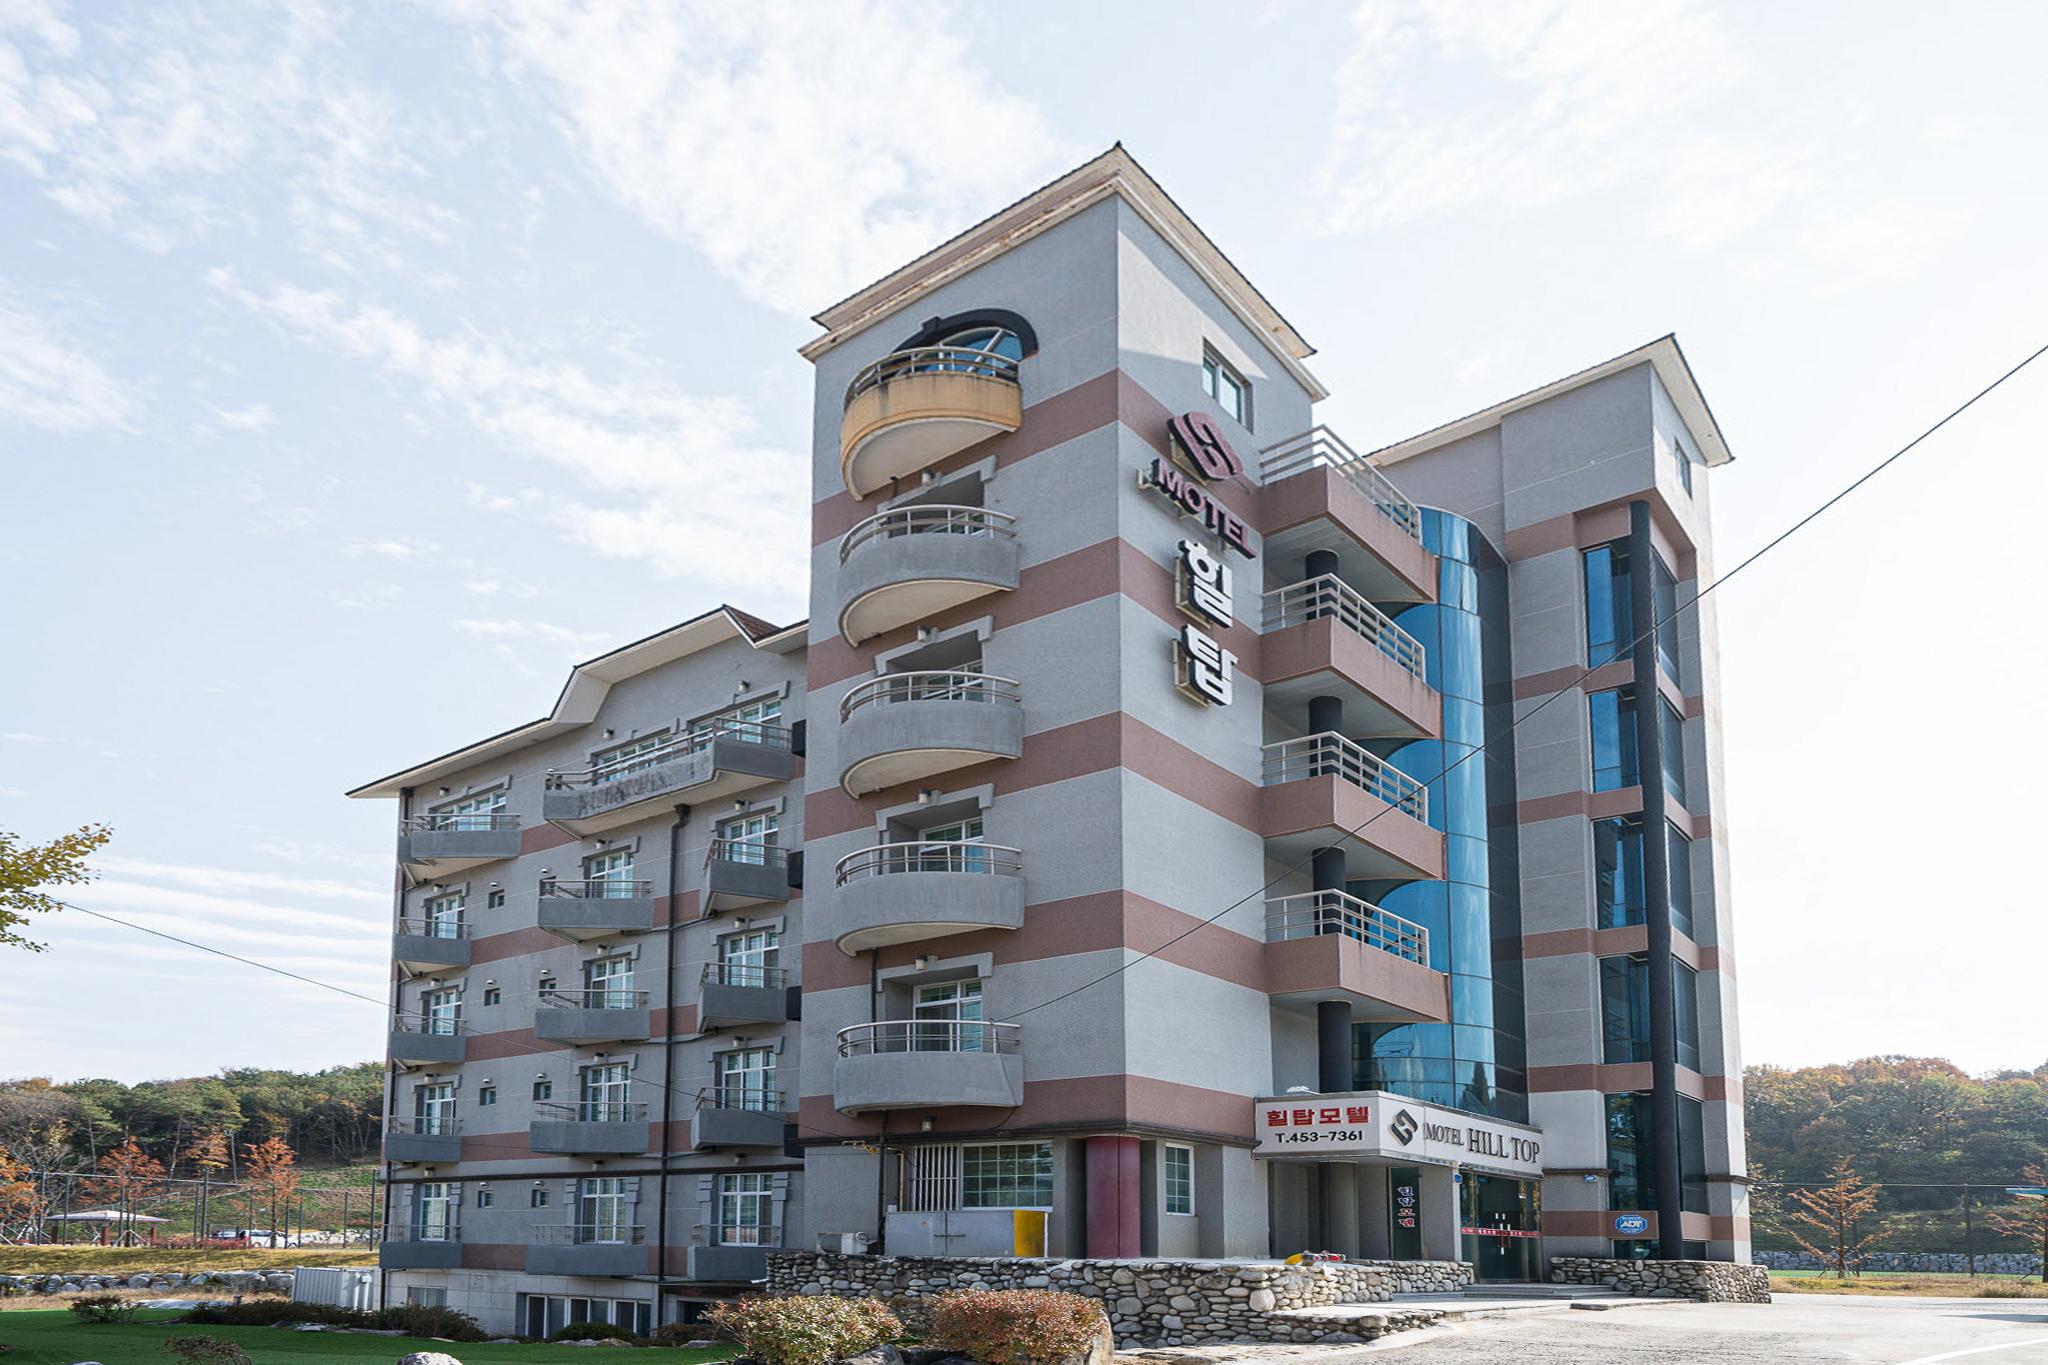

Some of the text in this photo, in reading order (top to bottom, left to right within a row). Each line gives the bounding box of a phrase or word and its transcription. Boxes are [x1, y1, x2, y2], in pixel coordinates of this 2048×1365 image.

[1151, 458, 1256, 559] MOTEL
[1178, 540, 1238, 707] 힐탑
[1266, 1106, 1369, 1127] 힐탑모텔
[1275, 1130, 1363, 1143] T.453-7361
[1423, 1122, 1541, 1164] MOTEL HILL TOP
[1620, 1220, 1643, 1228] ADT
